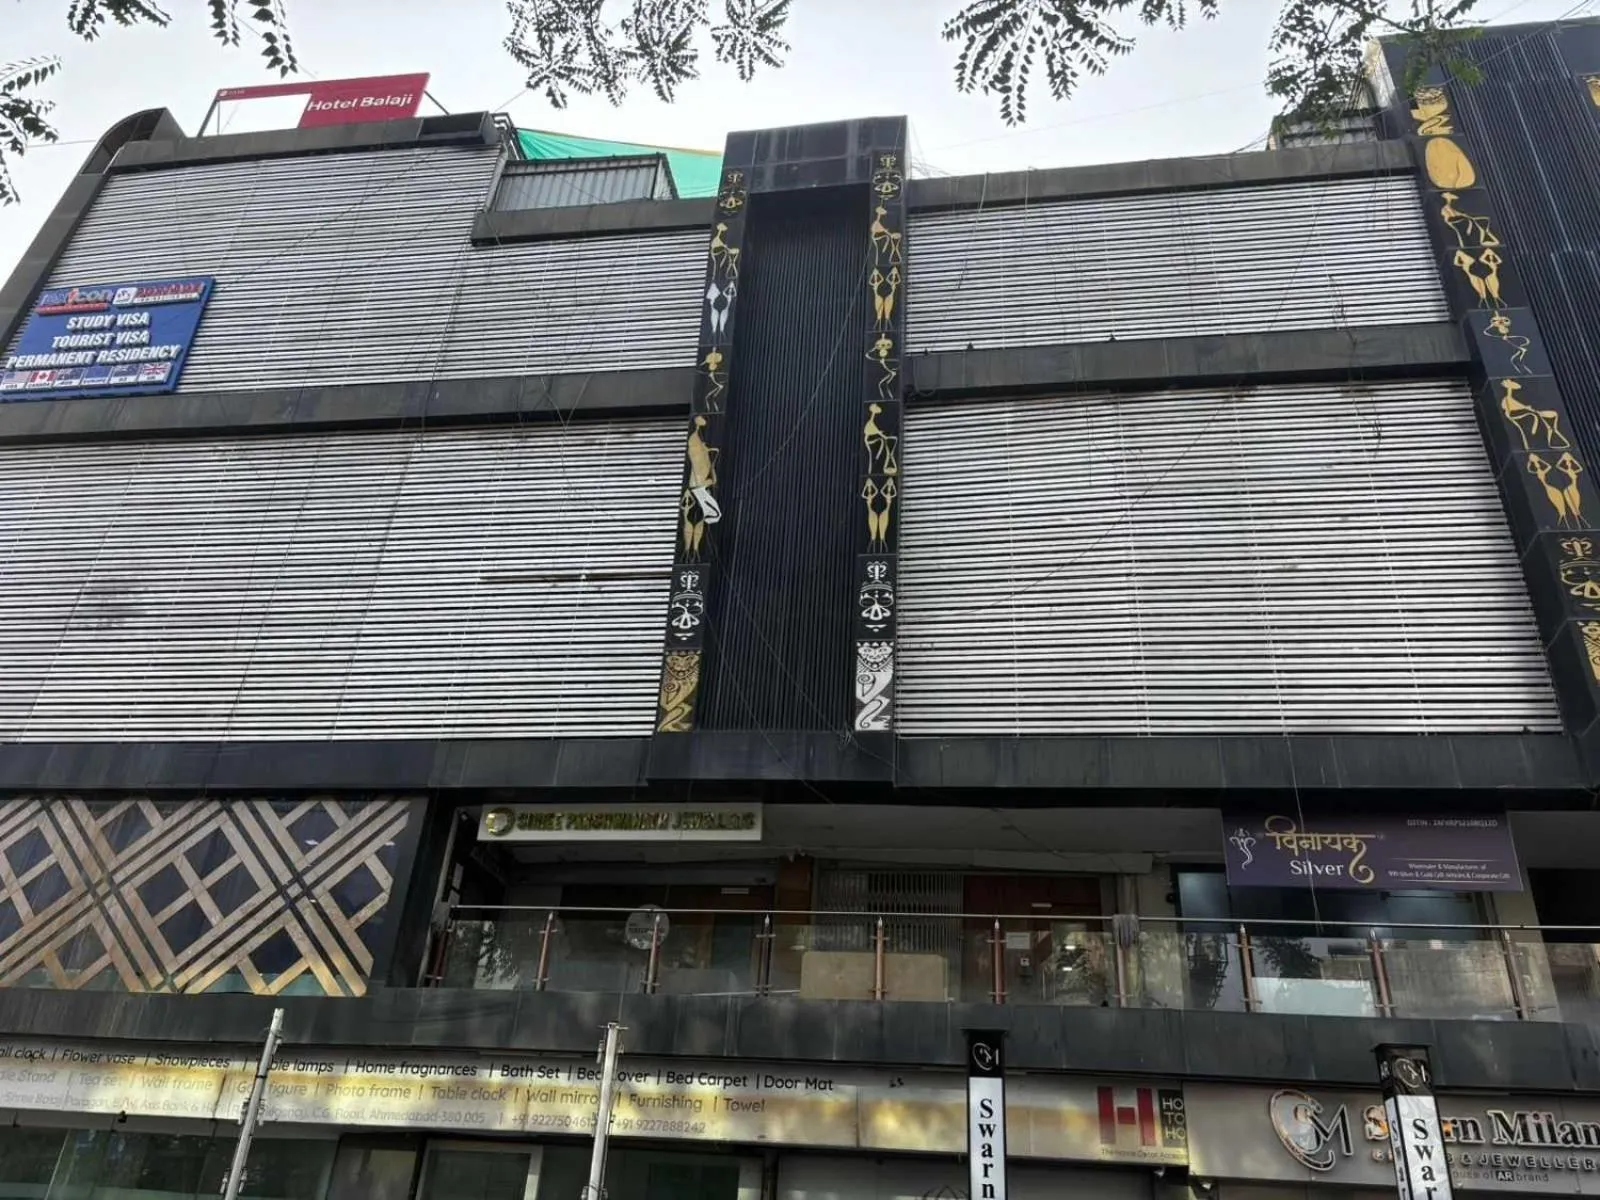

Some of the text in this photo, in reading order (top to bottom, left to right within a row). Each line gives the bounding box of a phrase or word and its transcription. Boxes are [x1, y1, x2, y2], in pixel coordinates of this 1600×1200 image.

[307, 93, 413, 112] Hotel Balaji
[66, 311, 150, 330] STUDY VISA
[52, 330, 150, 348] TOURIST VISA
[6, 344, 181, 369] PERMANENT RESIDENCY
[1265, 815, 1376, 884] विनायक
[1289, 859, 1344, 876] Silver
[15, 1046, 46, 1061] clock
[62, 1048, 103, 1064] Flower
[106, 1053, 136, 1065] vase
[155, 1052, 231, 1070] Showpieces
[293, 1059, 334, 1076] lamps
[355, 1060, 395, 1074] Home
[400, 1061, 478, 1078] fragnances
[500, 1064, 534, 1078] Bath
[538, 1065, 561, 1080] Set
[666, 1071, 695, 1085] Bed
[698, 1072, 748, 1090] Carpet
[764, 1075, 801, 1090] Door
[804, 1077, 833, 1092] Mat
[268, 1083, 308, 1098] figure
[325, 1083, 366, 1098] Photo
[369, 1083, 412, 1099] frame
[431, 1086, 467, 1100] Table
[470, 1087, 507, 1102] clock
[527, 1089, 556, 1104] Wall
[560, 1090, 599, 1105] mirro
[629, 1093, 703, 1113] Furnishing
[724, 1098, 766, 1112] Towel
[1162, 1098, 1184, 1111] HO
[1163, 1111, 1185, 1125] TO
[1165, 1126, 1186, 1140] HO
[977, 1098, 997, 1199] Swarn
[1497, 1170, 1515, 1183] AR
[1516, 1171, 1550, 1183] brand
